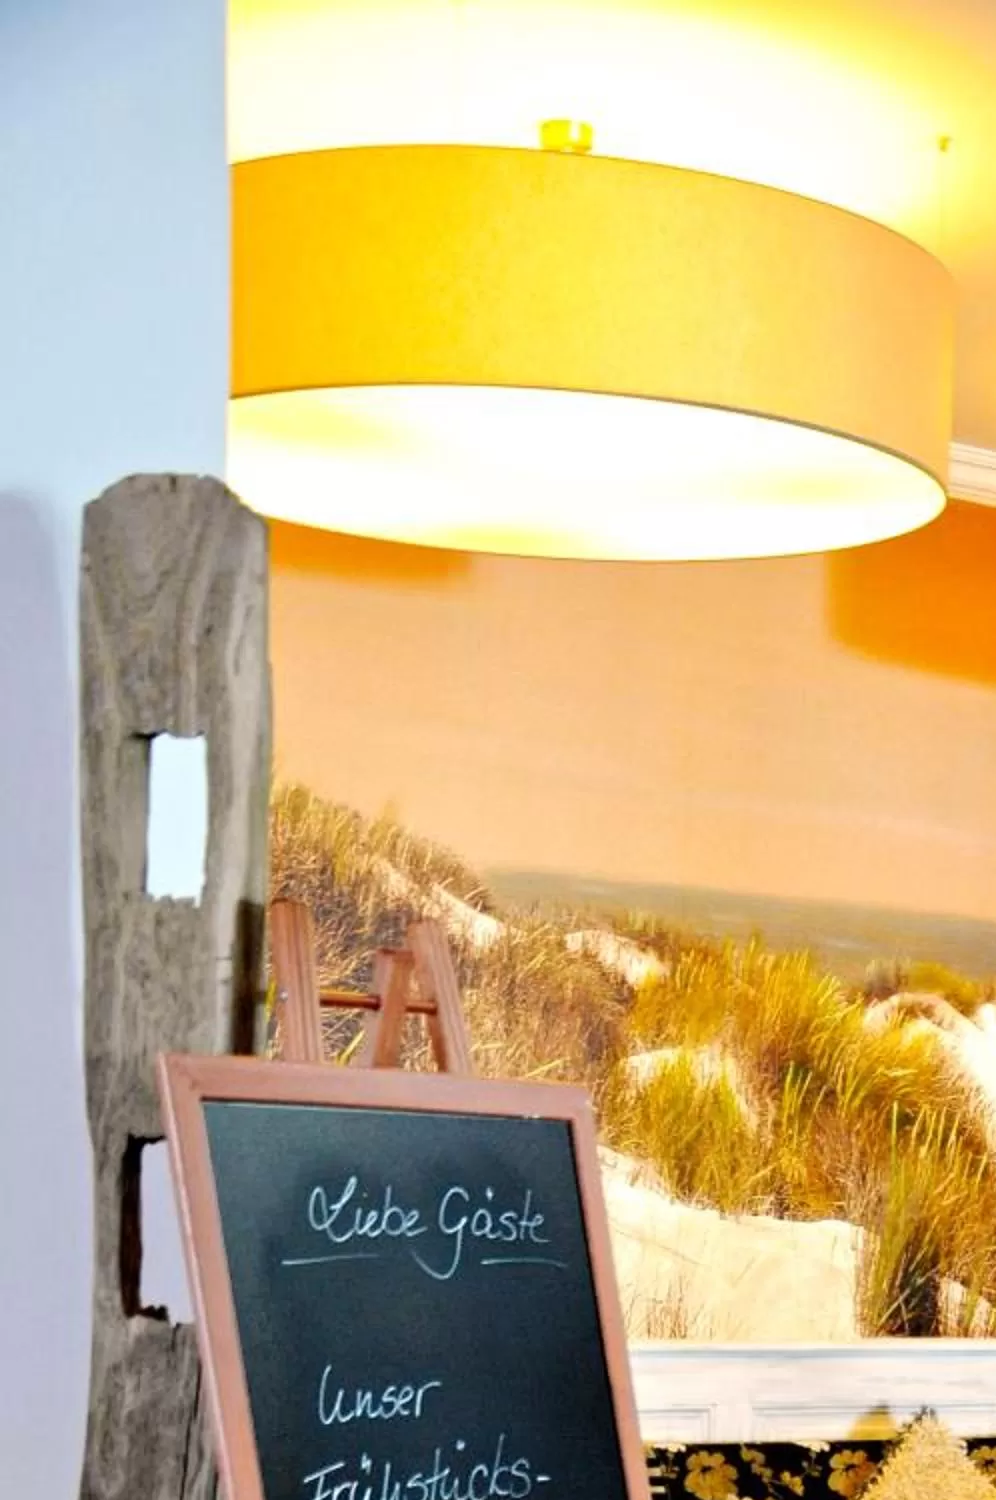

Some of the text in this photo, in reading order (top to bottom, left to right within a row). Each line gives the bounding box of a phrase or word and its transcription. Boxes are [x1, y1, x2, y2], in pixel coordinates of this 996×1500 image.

[308, 1174, 550, 1280] Liebe Gäste
[318, 1365, 442, 1425] Unser
